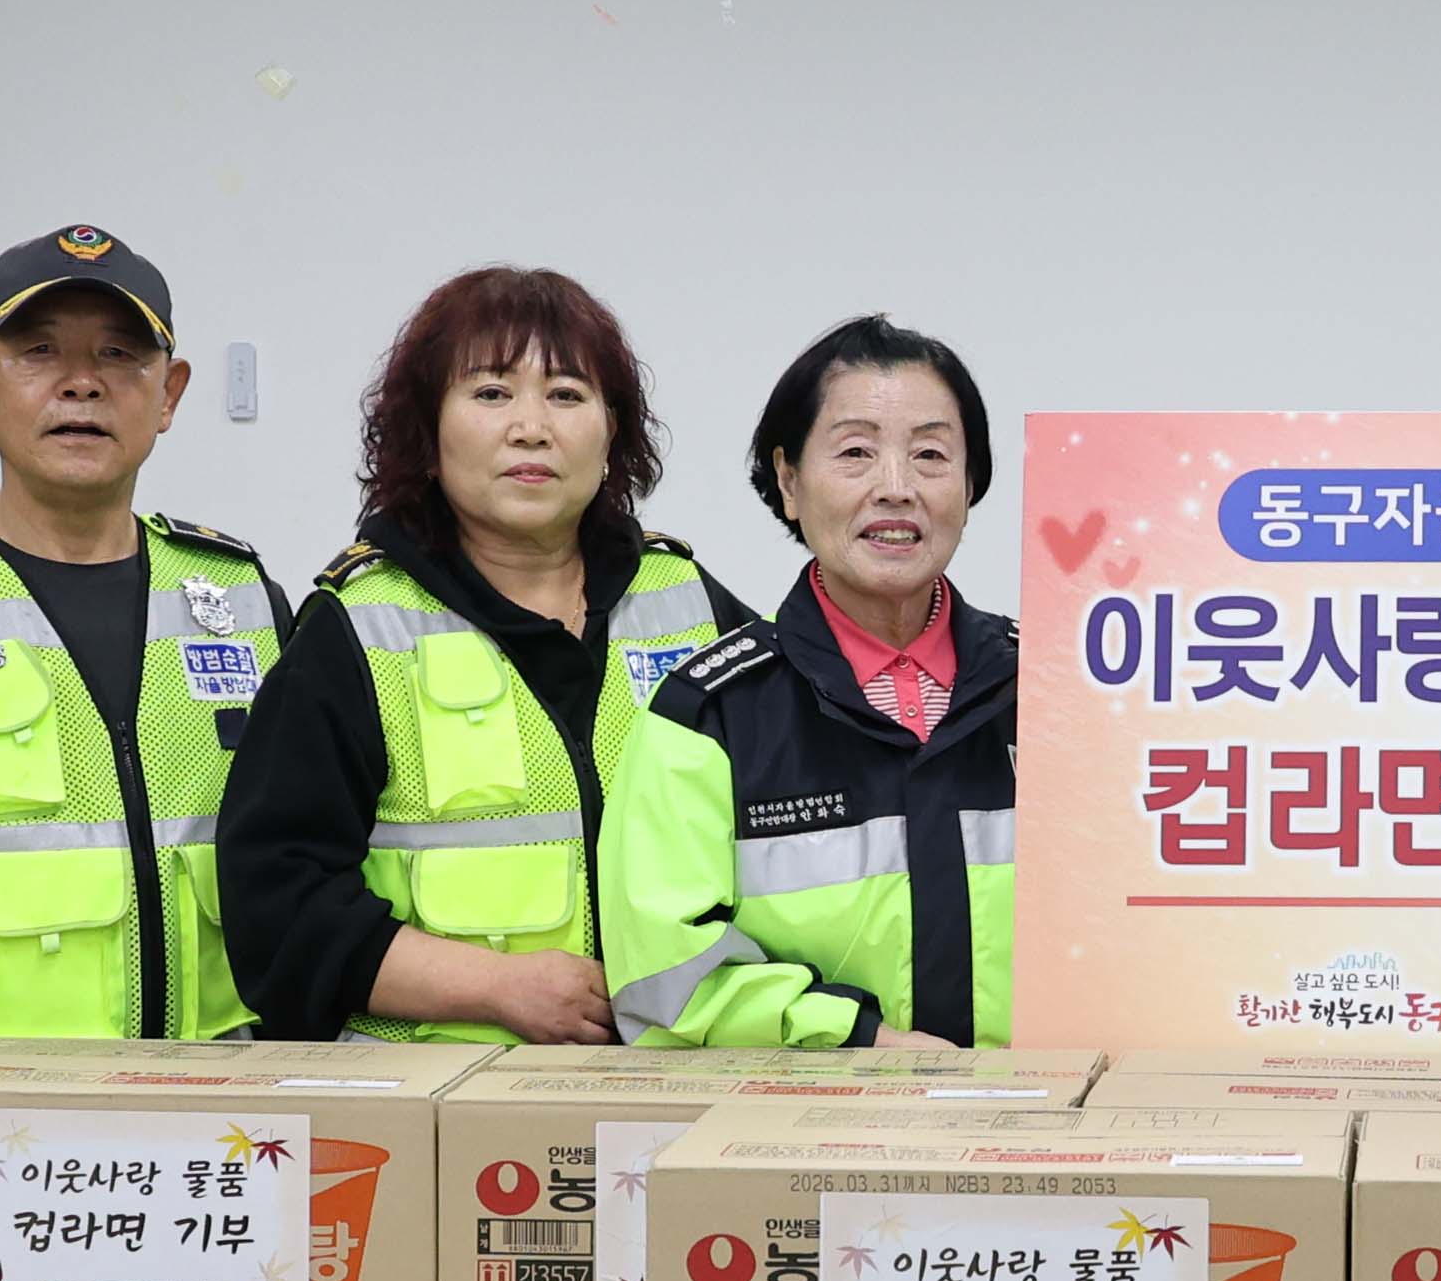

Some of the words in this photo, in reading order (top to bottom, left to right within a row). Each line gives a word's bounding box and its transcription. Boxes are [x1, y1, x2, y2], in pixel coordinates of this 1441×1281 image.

[1294, 972, 1325, 992] 살고
[1329, 973, 1360, 992] 싶은
[1364, 973, 1400, 991] 도시!
[1236, 994, 1302, 1028] 활기찬
[1308, 997, 1394, 1030] 행복도시
[21, 1158, 162, 1196] 이웃사랑
[182, 1160, 248, 1199] 물품
[945, 1176, 990, 1193] N2B3
[1072, 1177, 1116, 1195] 2053
[14, 1210, 146, 1253] 컵라면
[174, 1213, 255, 1255] 기부
